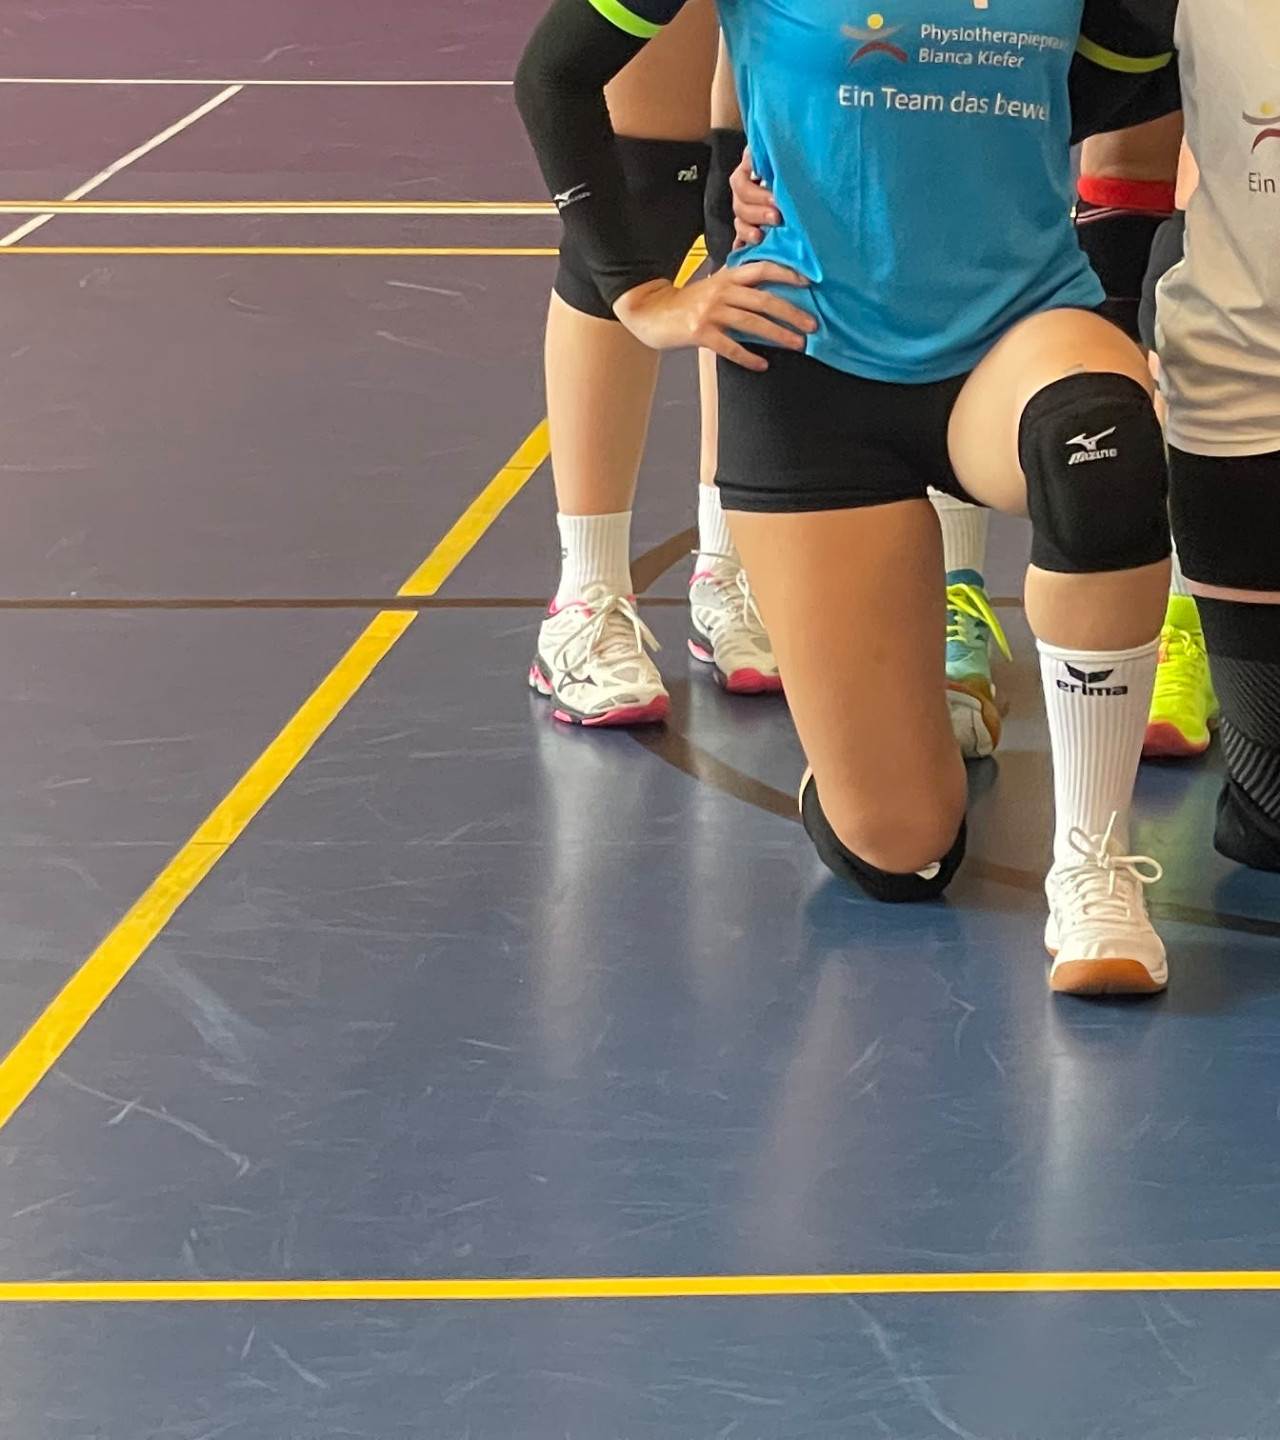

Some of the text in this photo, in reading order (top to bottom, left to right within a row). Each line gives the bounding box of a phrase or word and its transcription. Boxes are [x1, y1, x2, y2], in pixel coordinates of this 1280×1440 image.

[918, 48, 1024, 68] Bianca Kiefer
[838, 85, 1050, 122] Ein Team das bewe
[1248, 172, 1276, 193] Ein
[1056, 679, 1128, 696] erima
